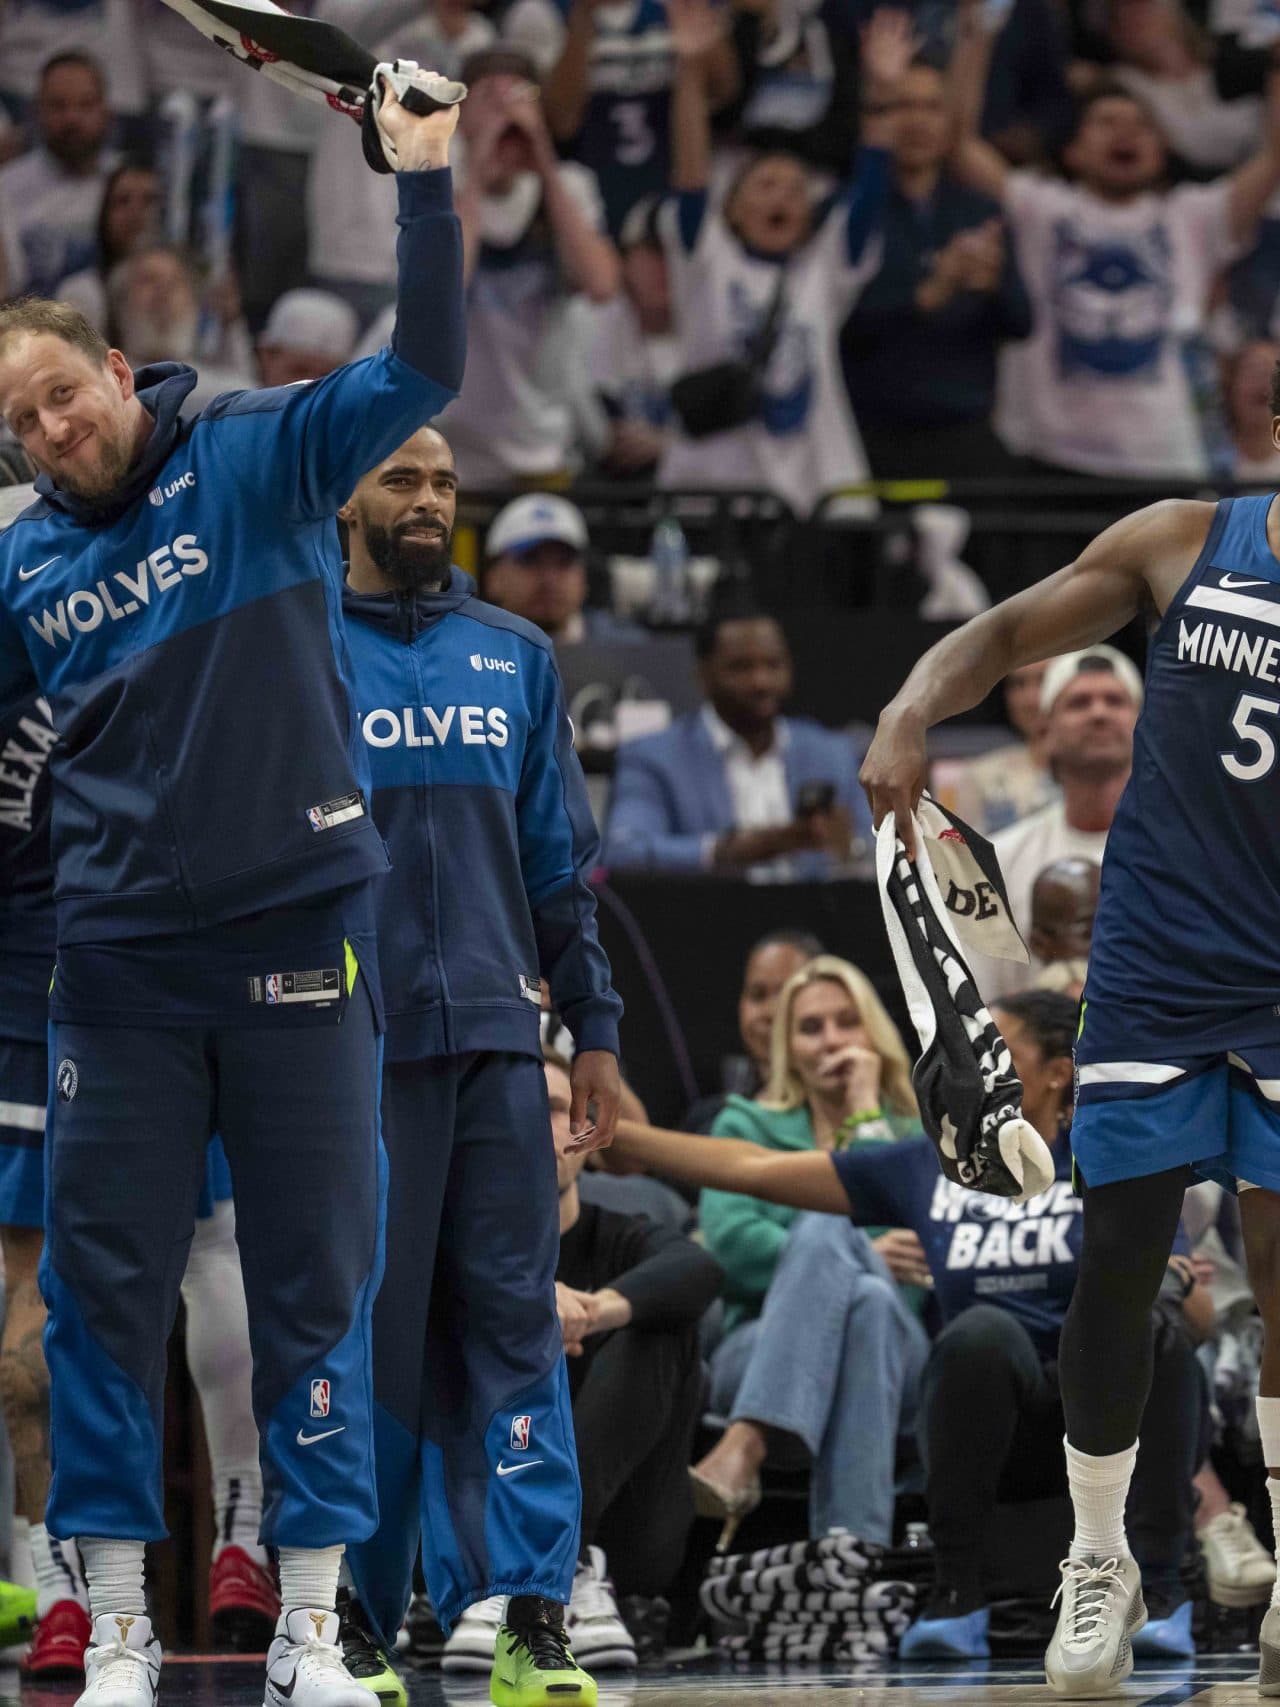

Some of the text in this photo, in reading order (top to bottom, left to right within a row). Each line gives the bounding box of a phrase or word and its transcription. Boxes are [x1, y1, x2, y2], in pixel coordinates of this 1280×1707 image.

[164, 472, 196, 499] UHC
[28, 534, 209, 649] WOLVES
[483, 657, 517, 674] UHC
[358, 706, 509, 748] OLVES
[1220, 694, 1280, 780] 5
[946, 1214, 1074, 1270] BACK
